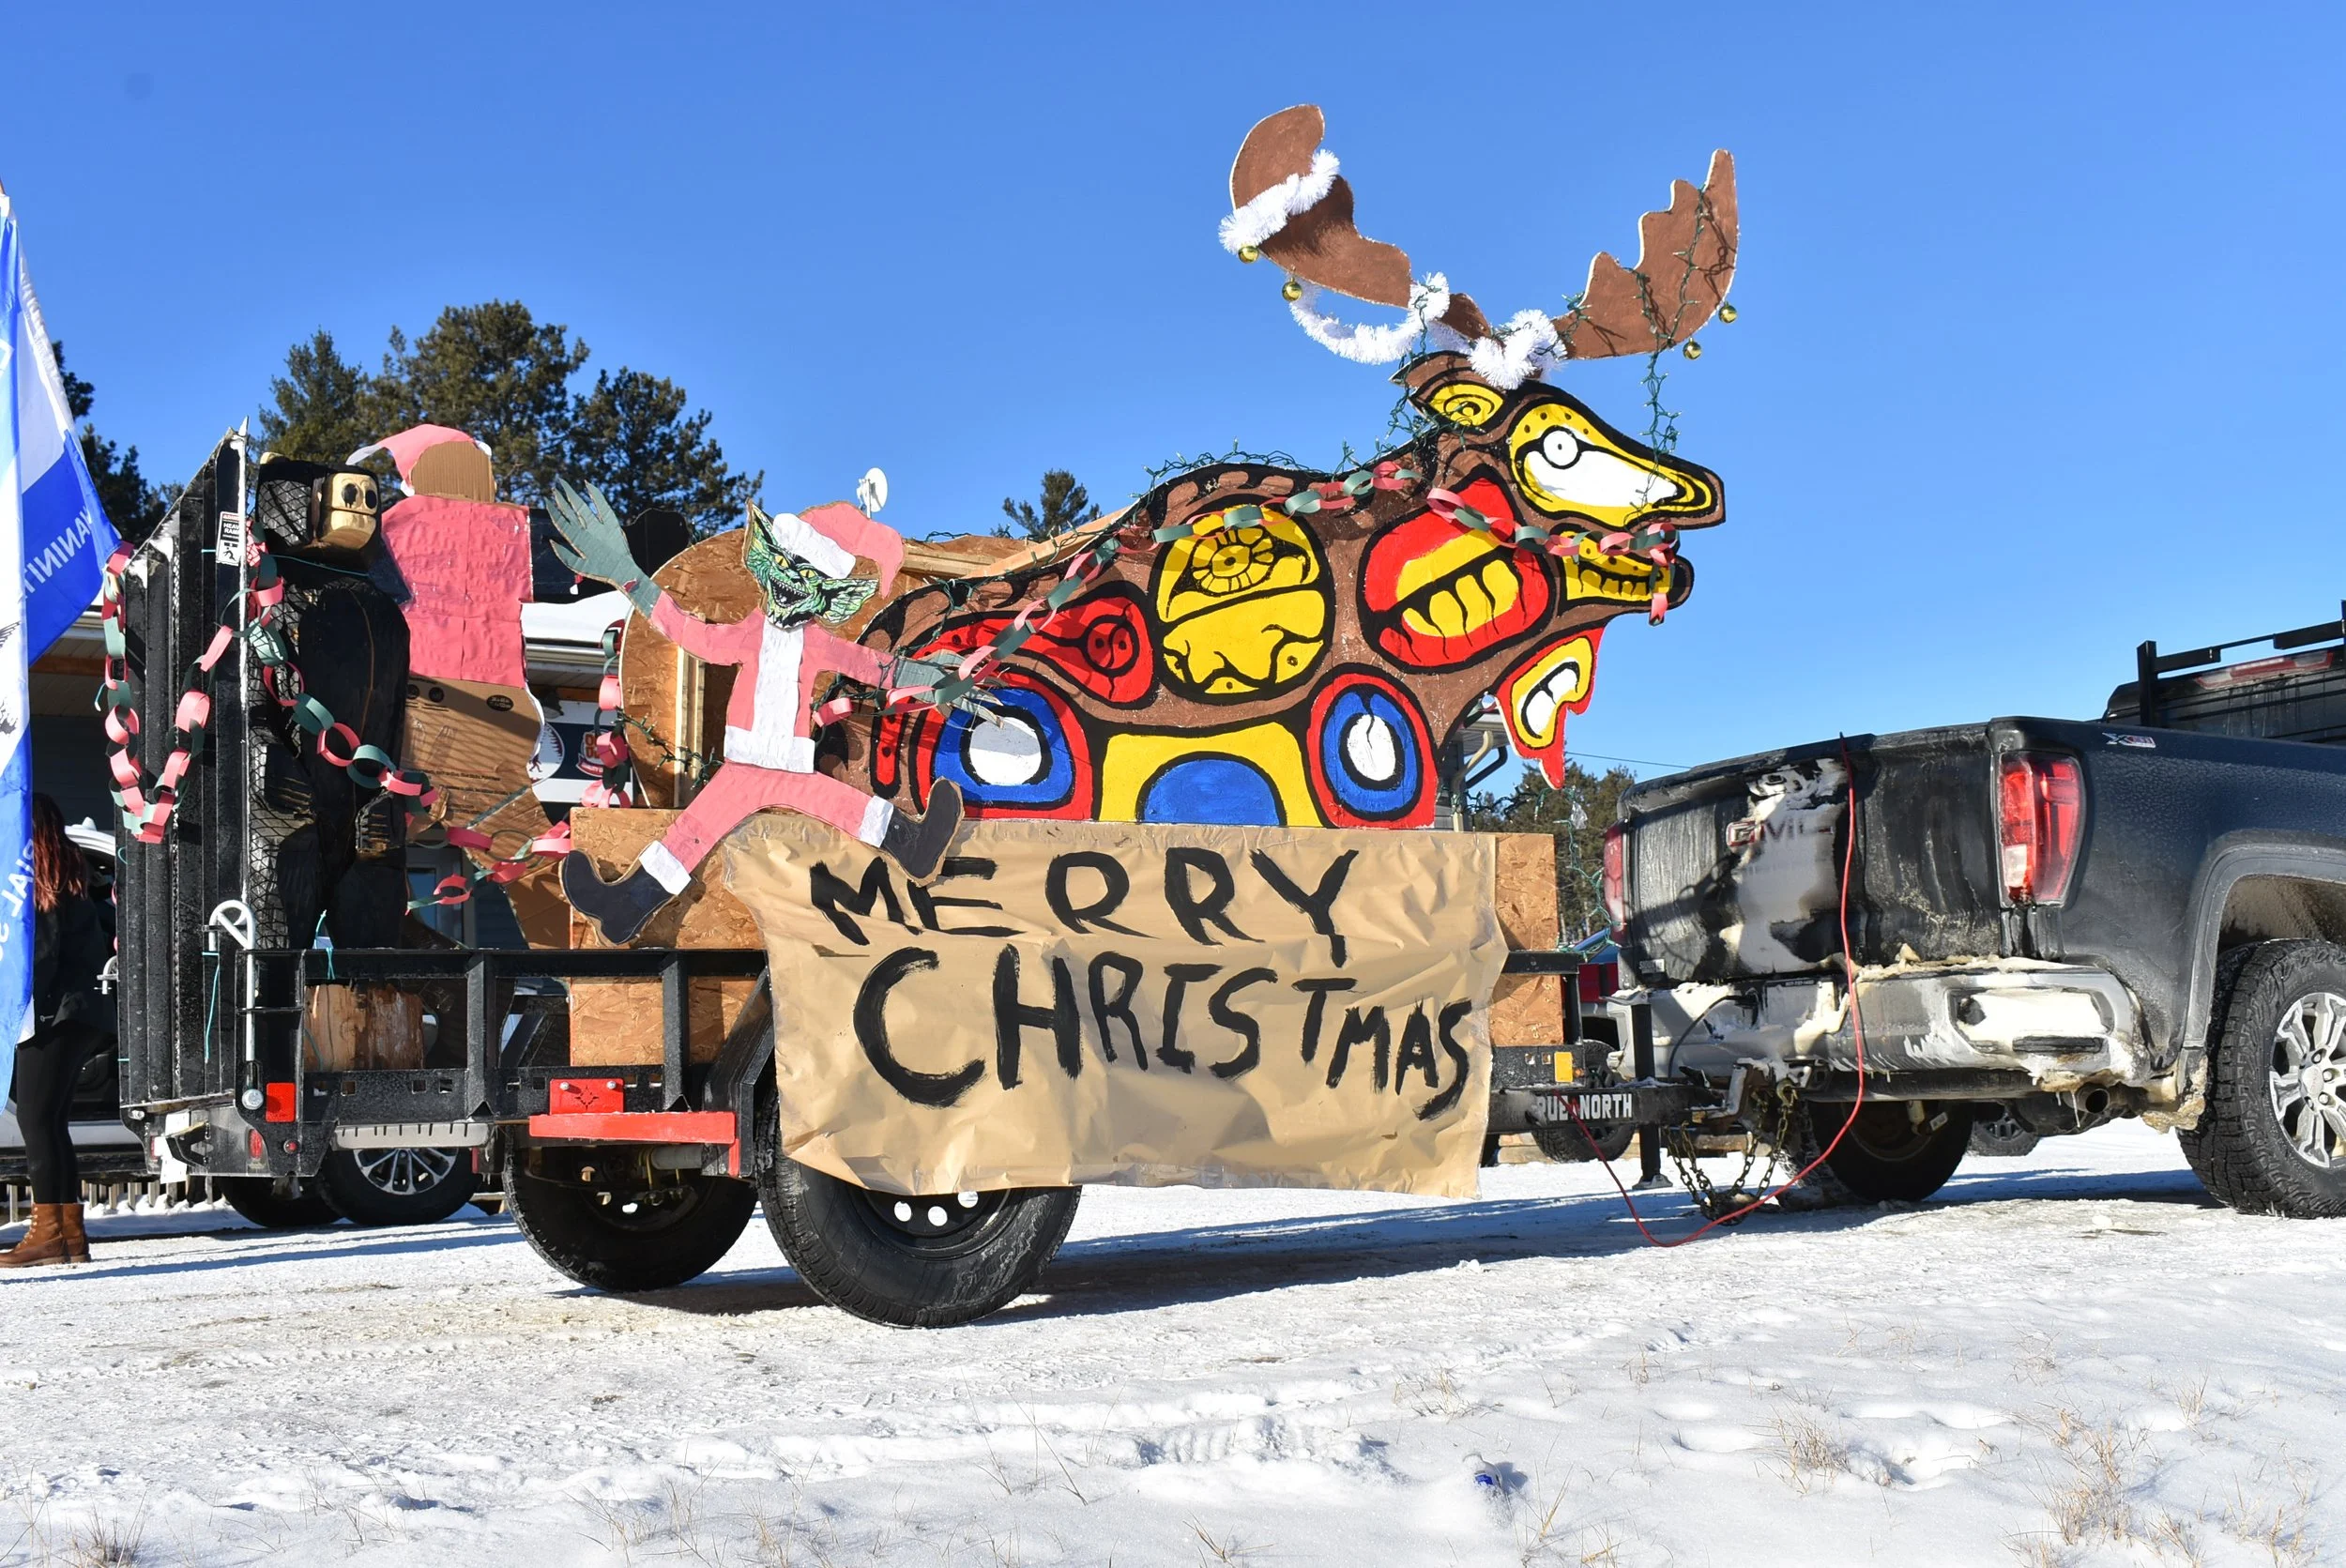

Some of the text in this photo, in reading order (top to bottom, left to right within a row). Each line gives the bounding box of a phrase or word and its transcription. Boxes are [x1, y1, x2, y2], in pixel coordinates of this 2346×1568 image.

[810, 846, 1359, 968] MERRY
[853, 943, 1473, 1121] CHRISTMAS
[1529, 1093, 1633, 1121] RUE NORTH
